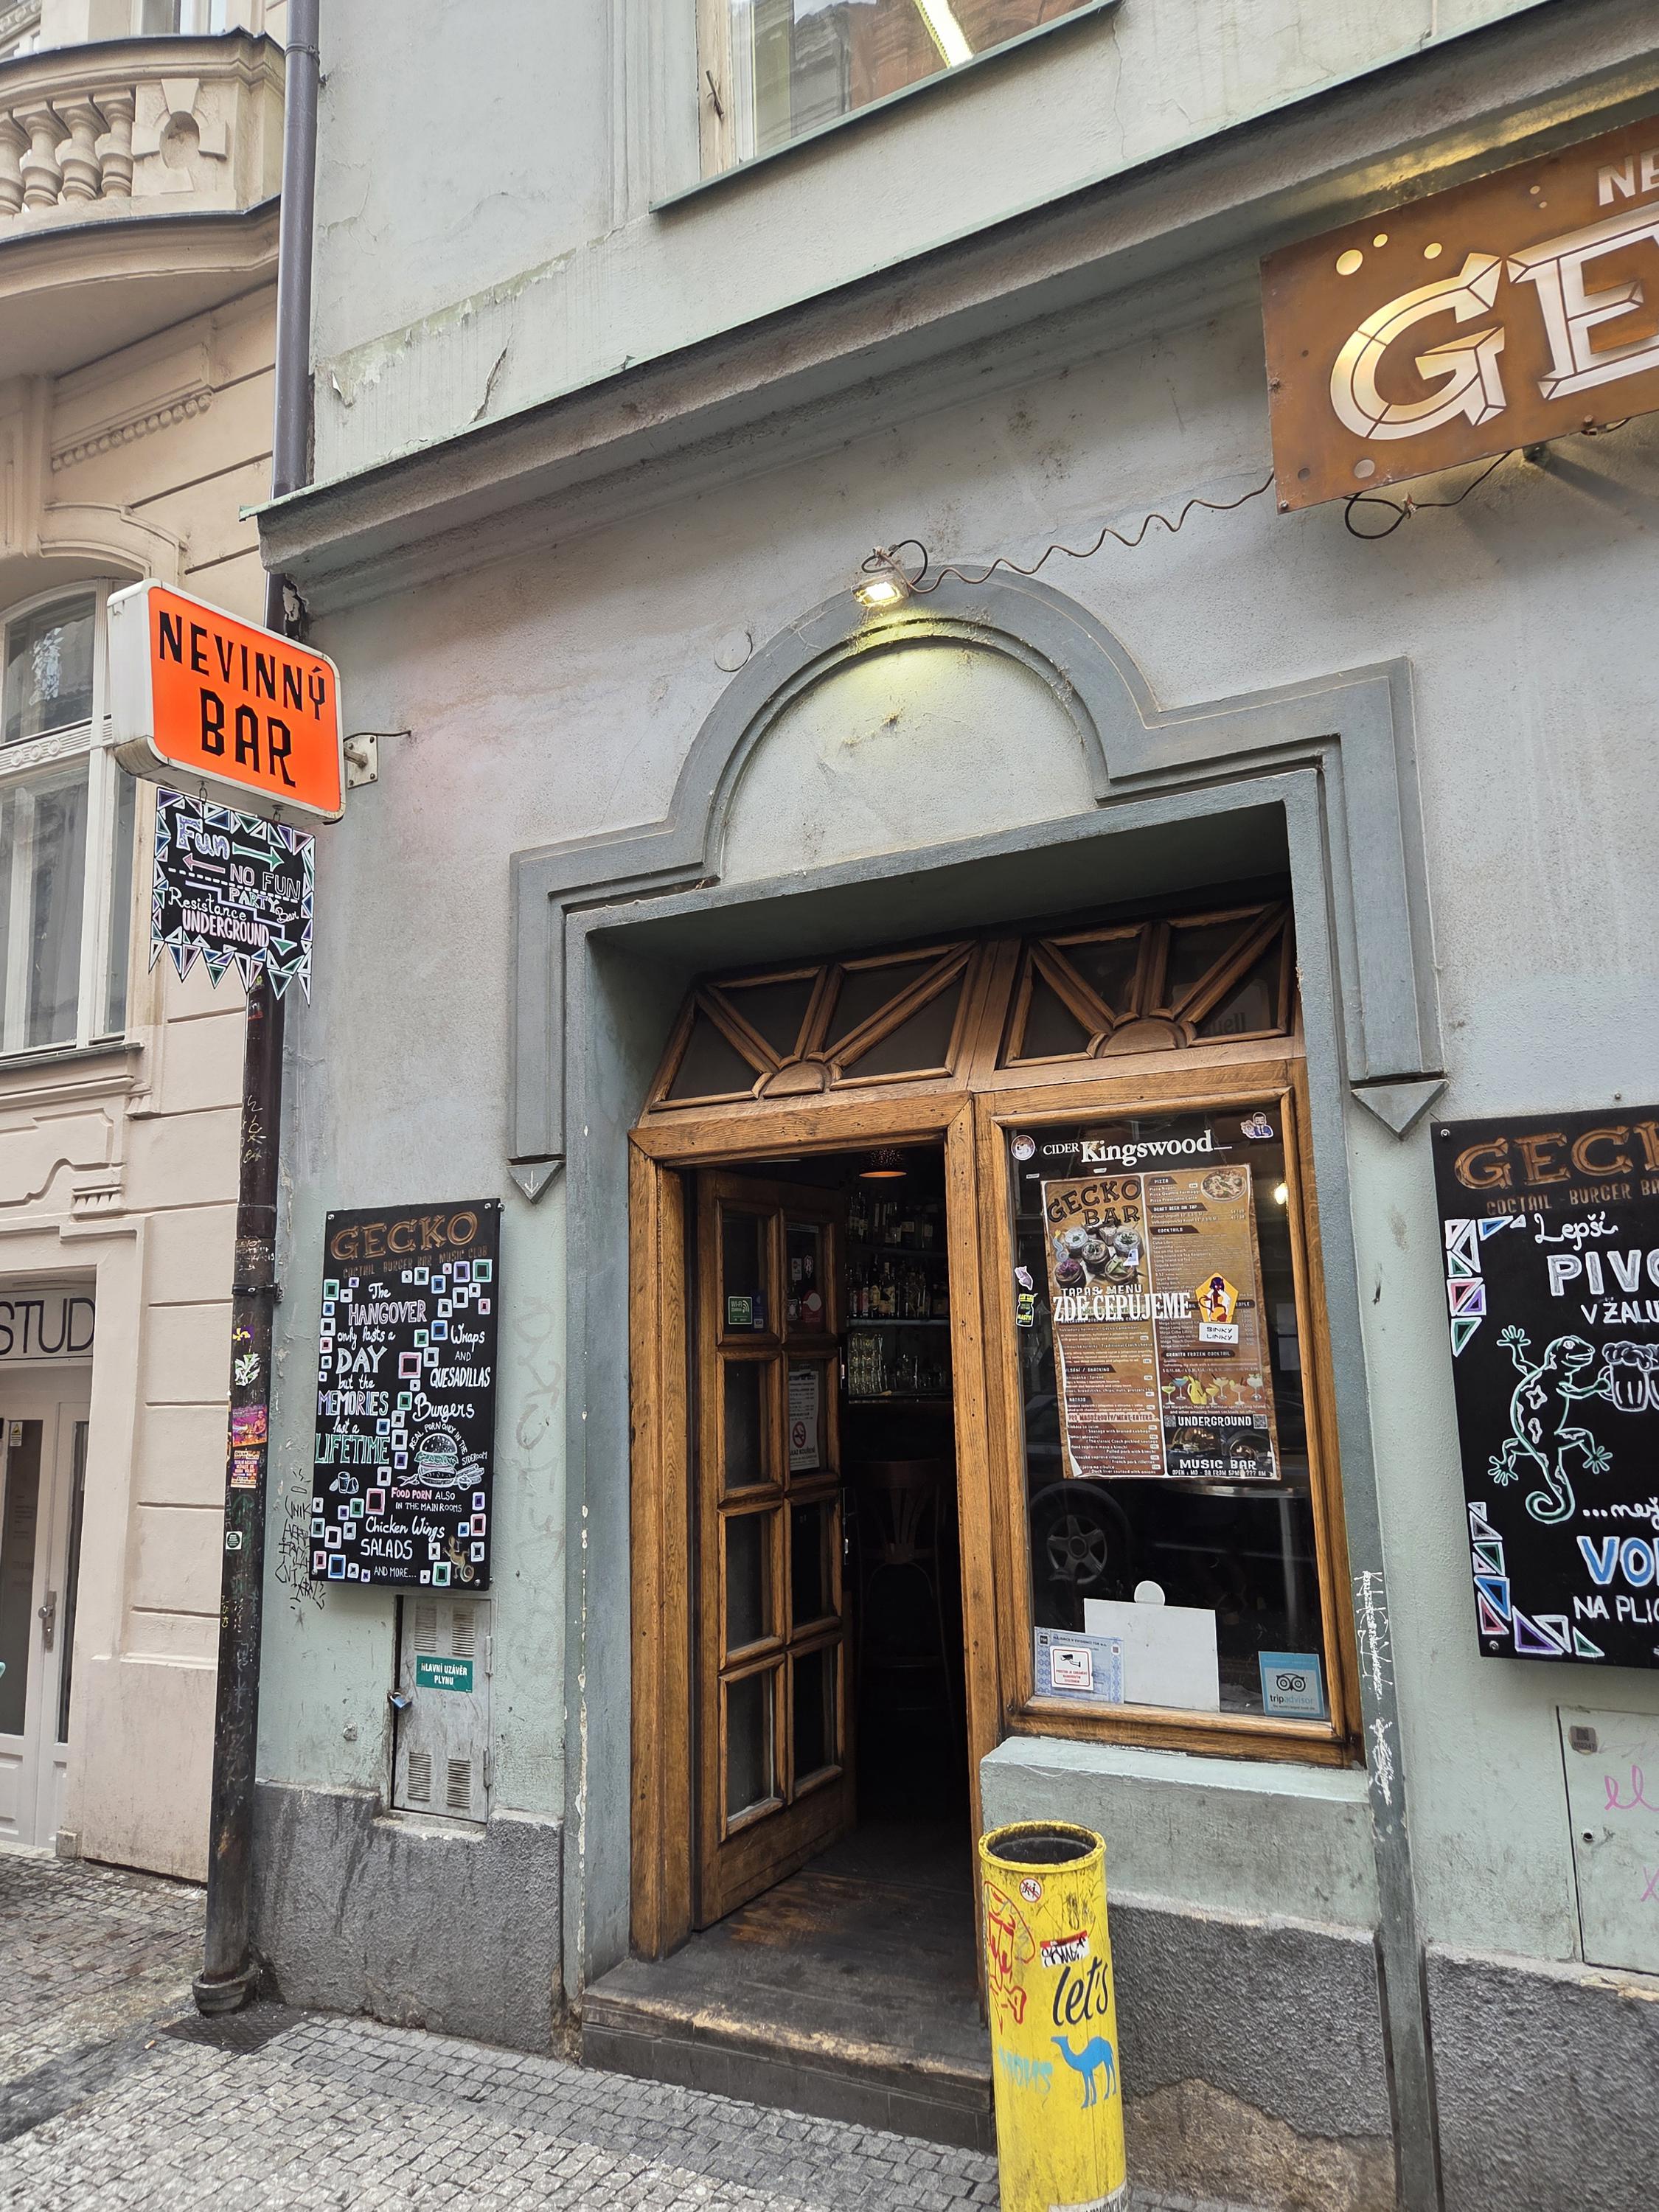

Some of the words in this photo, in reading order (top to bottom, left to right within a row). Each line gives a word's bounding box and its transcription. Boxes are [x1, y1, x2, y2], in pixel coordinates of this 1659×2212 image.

[159, 611, 325, 721] NEVINNÝ
[199, 687, 296, 788] BAR
[175, 813, 230, 860] Fun
[230, 864, 255, 886] NO
[262, 872, 301, 900] FUN
[168, 887, 247, 921] Resistance
[229, 888, 279, 914] PARTY
[182, 909, 269, 947] UNDERGROUND
[1043, 1142, 1079, 1155] CIDER
[1079, 1130, 1214, 1167] Kingswood
[1046, 1179, 1143, 1222] GECKO
[1569, 1182, 1632, 1205] BURGER
[1082, 1205, 1141, 1227] BAR
[330, 1211, 478, 1260] GECKO
[1534, 1211, 1618, 1251] Lepší
[383, 1258, 413, 1273] BURGER
[439, 1250, 465, 1264] MUSIC
[369, 1282, 391, 1299] The
[1062, 1287, 1099, 1296] TAPAS
[1106, 1284, 1142, 1294] MENU
[348, 1300, 427, 1326] HANGOVER
[1052, 1296, 1089, 1322] ZDE
[1093, 1288, 1192, 1321] ČEPUJEME
[1580, 1304, 1598, 1324] V
[337, 1326, 358, 1350] only
[363, 1326, 385, 1342] lasts
[388, 1333, 396, 1341] a
[451, 1323, 485, 1352] Wraps
[335, 1345, 388, 1374] DAY
[455, 1351, 471, 1362] AND
[338, 1374, 353, 1389] but
[359, 1374, 375, 1389] the
[430, 1366, 491, 1388] QUESADILLAS
[318, 1391, 389, 1416] MEMORIES
[412, 1392, 475, 1422] Burgers
[333, 1416, 350, 1433] last
[352, 1425, 360, 1433] a
[424, 1422, 442, 1433] PORN
[442, 1422, 456, 1434] ONLY
[1178, 1416, 1252, 1427] UNDERGROUND
[408, 1431, 424, 1450] REAL
[453, 1431, 462, 1441] IN
[459, 1439, 468, 1455] THE
[315, 1433, 390, 1464] LIFETIME
[462, 1451, 488, 1466] SIDEROOM
[1180, 1459, 1222, 1469] MUSIC
[1231, 1459, 1257, 1470] BAR
[391, 1487, 410, 1499] FOOD
[411, 1489, 433, 1500] PORN
[435, 1490, 455, 1500] ALSO
[405, 1502, 419, 1511] THE
[420, 1503, 439, 1512] MAIN
[439, 1504, 462, 1513] ROOMS
[366, 1515, 408, 1534] Chicken
[411, 1515, 445, 1543] Wings
[360, 1538, 413, 1560] SALADS
[374, 1566, 388, 1576] AND
[1576, 1536, 1659, 1587] VO
[1573, 1596, 1610, 1619] NA
[421, 1663, 443, 1673] HLAVNÍ
[444, 1663, 467, 1676] UZÁVĚR
[434, 1675, 454, 1686] PLYNU
[1270, 1694, 1312, 1705] tripadvisor
